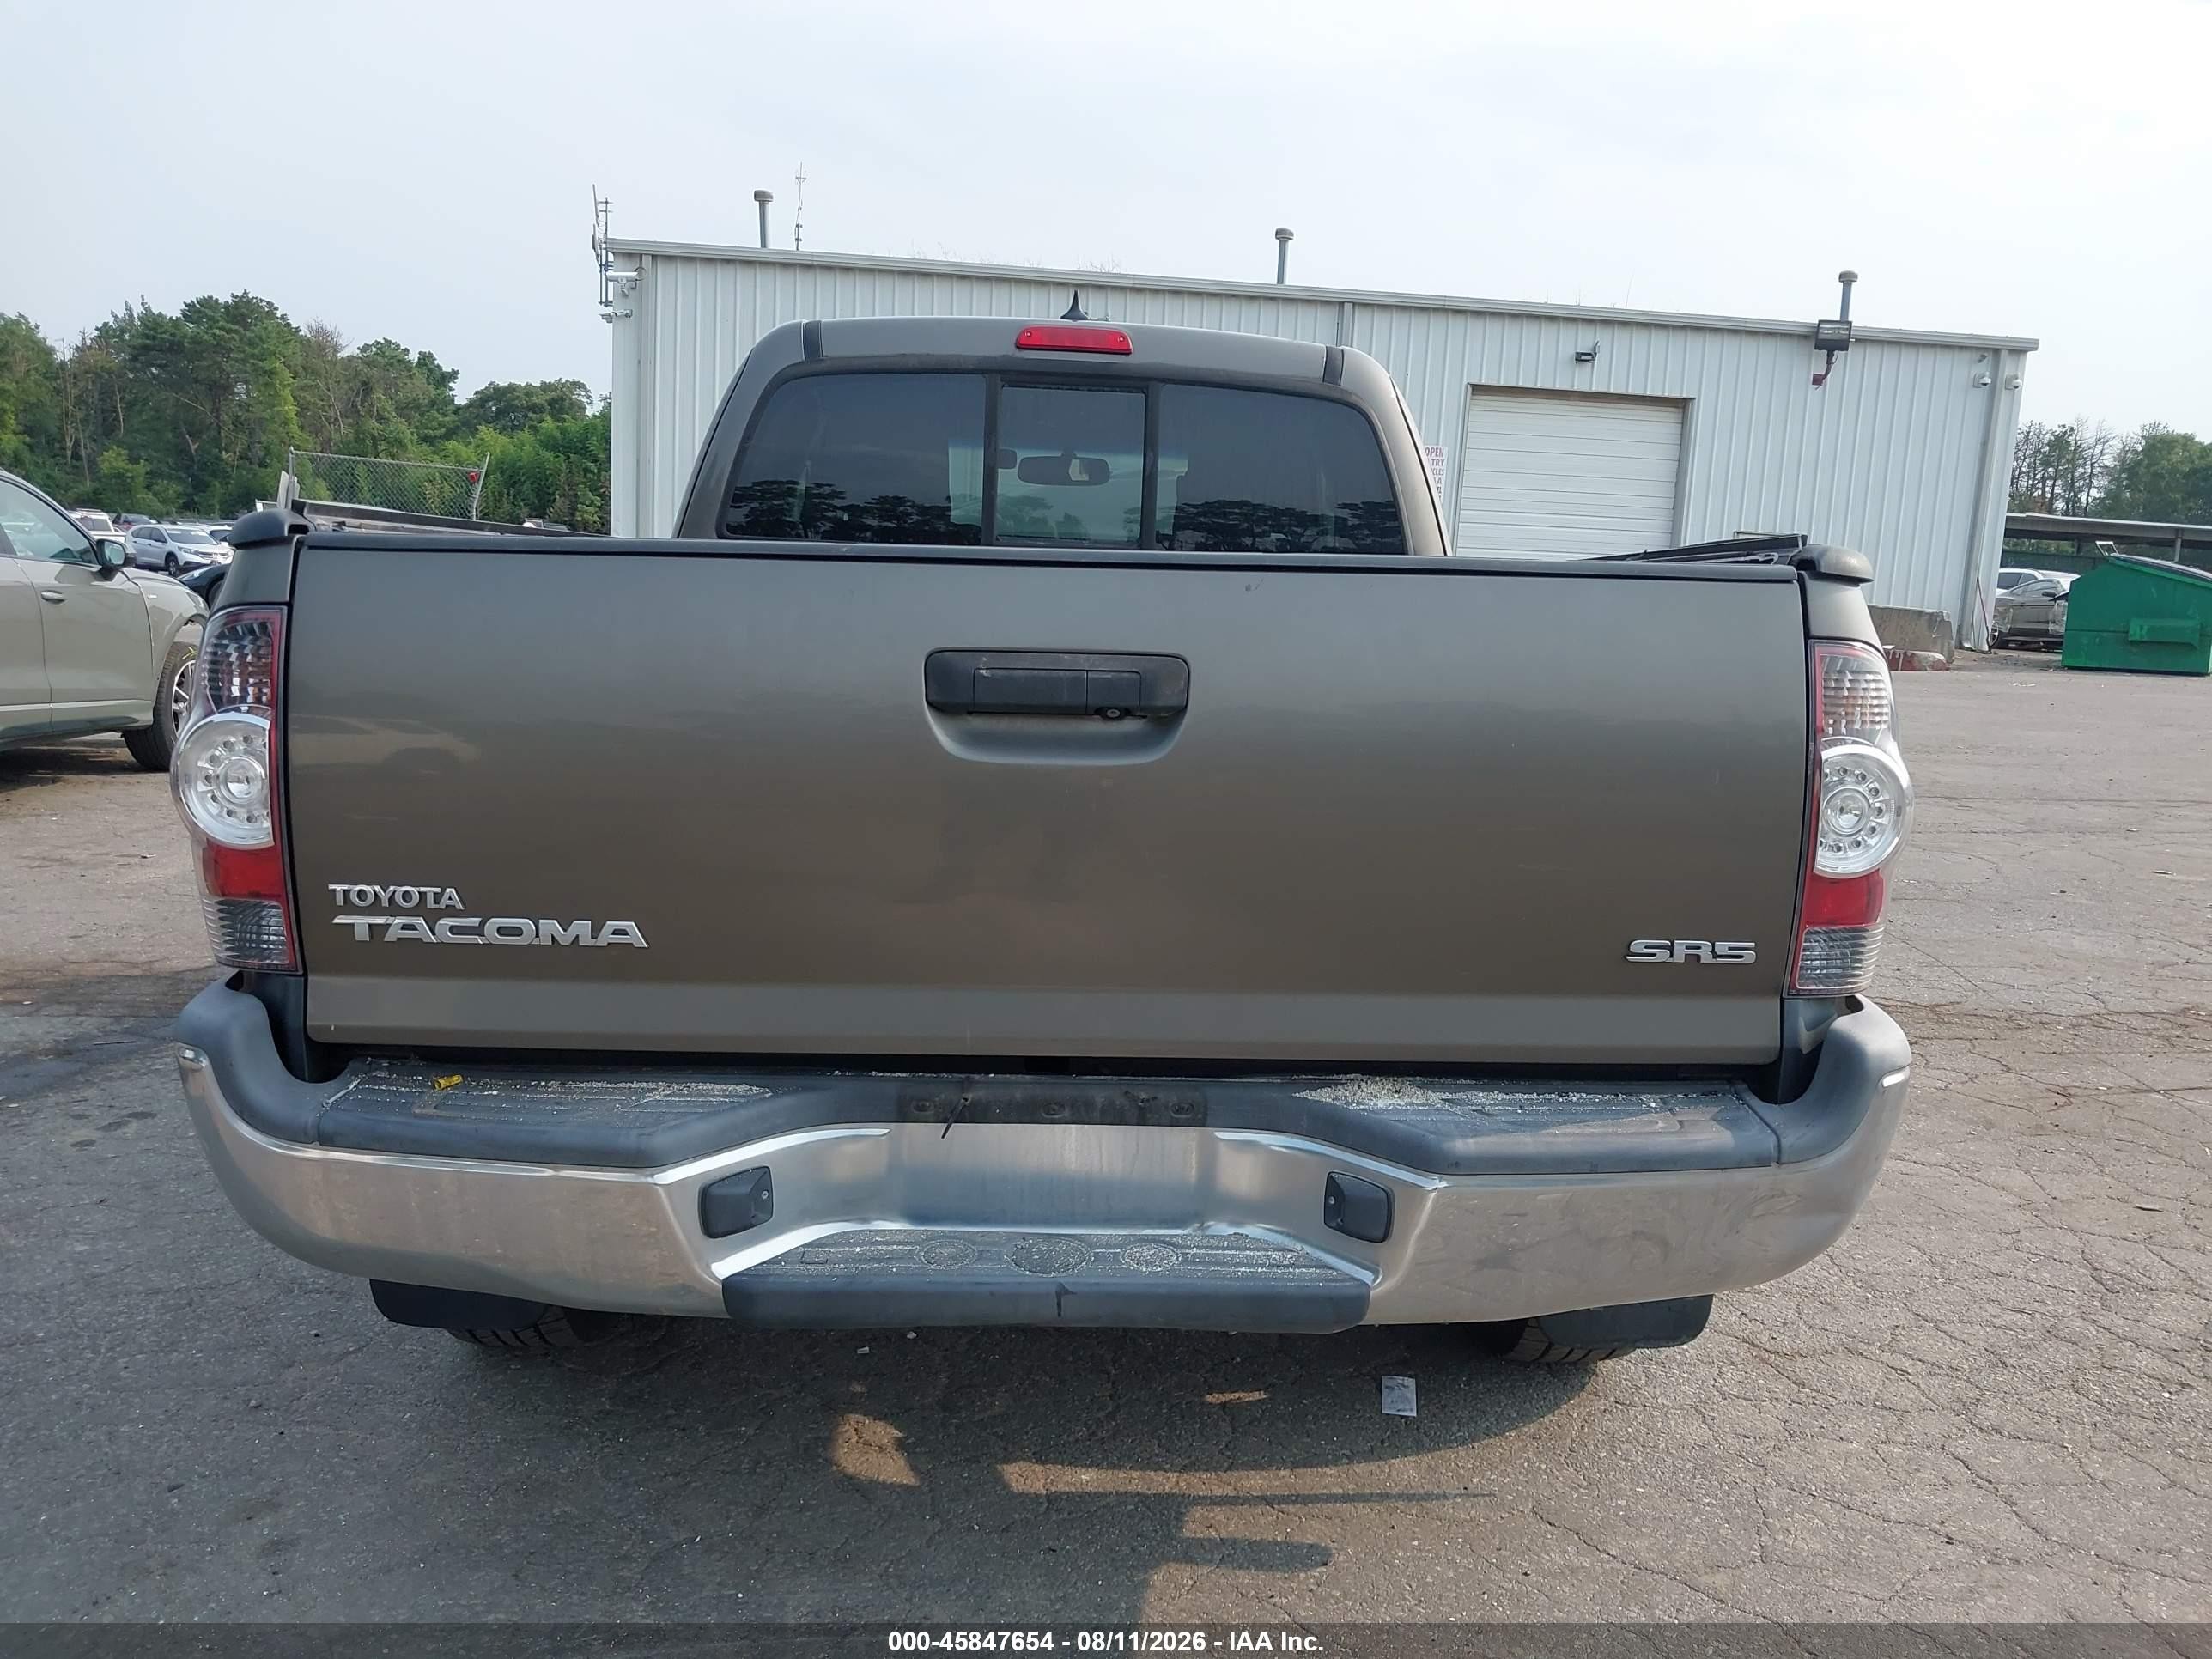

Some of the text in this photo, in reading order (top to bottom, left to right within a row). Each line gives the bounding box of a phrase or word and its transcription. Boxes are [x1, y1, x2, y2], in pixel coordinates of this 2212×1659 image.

[1425, 447, 1444, 458] OPEN
[328, 884, 465, 910] TOYOTA
[332, 915, 649, 948] TACOMA
[1625, 939, 1757, 964] SR5
